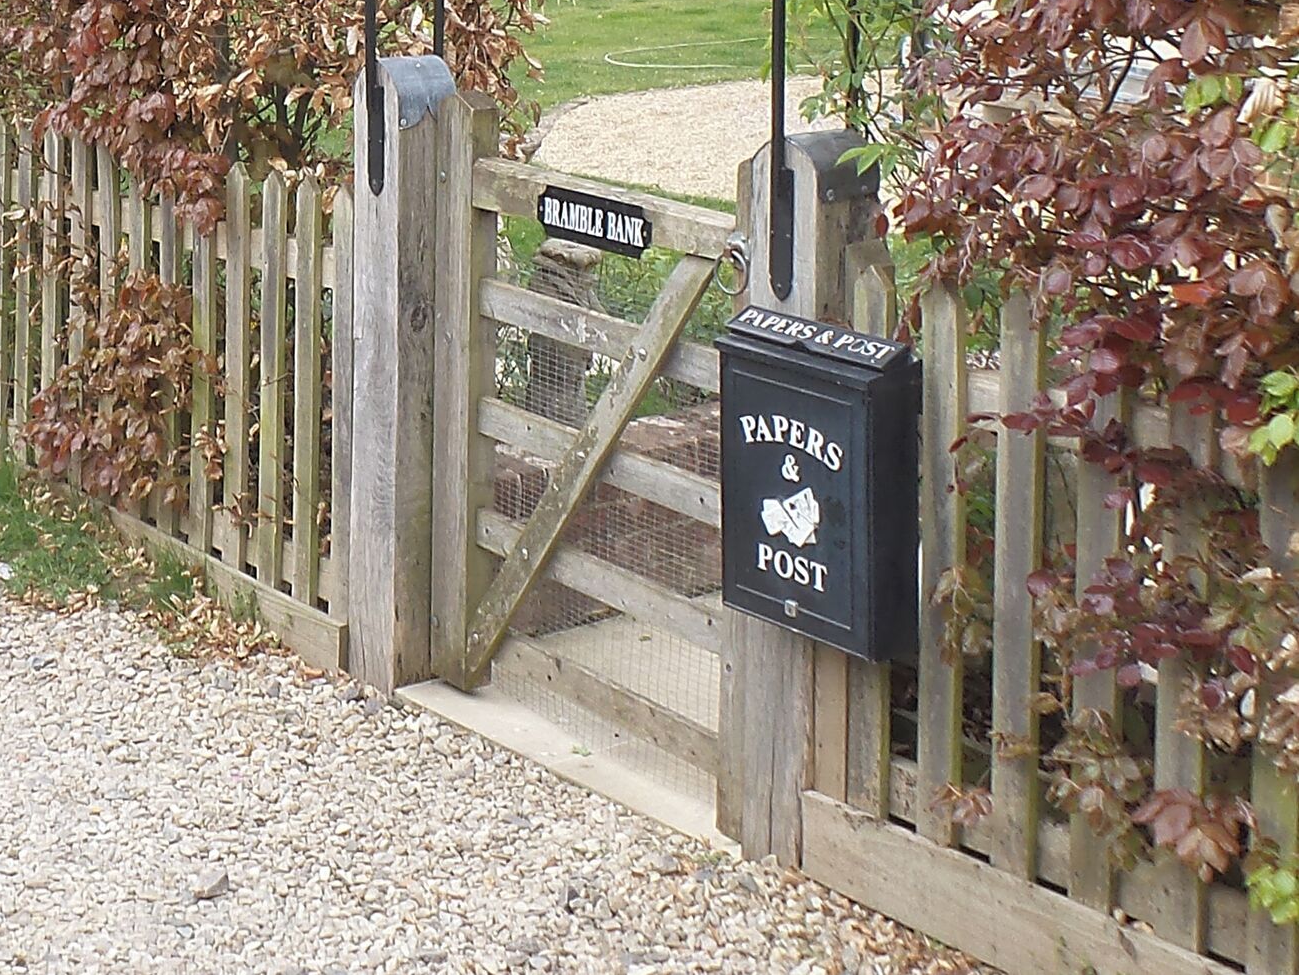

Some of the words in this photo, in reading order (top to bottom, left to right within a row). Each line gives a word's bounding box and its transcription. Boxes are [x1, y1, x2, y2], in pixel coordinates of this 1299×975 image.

[544, 197, 603, 237] BRAMBLE
[606, 212, 644, 248] BANK
[738, 309, 818, 340] PAPERS
[814, 329, 834, 345] &
[833, 333, 895, 361] POST
[739, 414, 844, 472] PAPERS
[781, 454, 800, 483] &
[757, 543, 828, 593] POST
